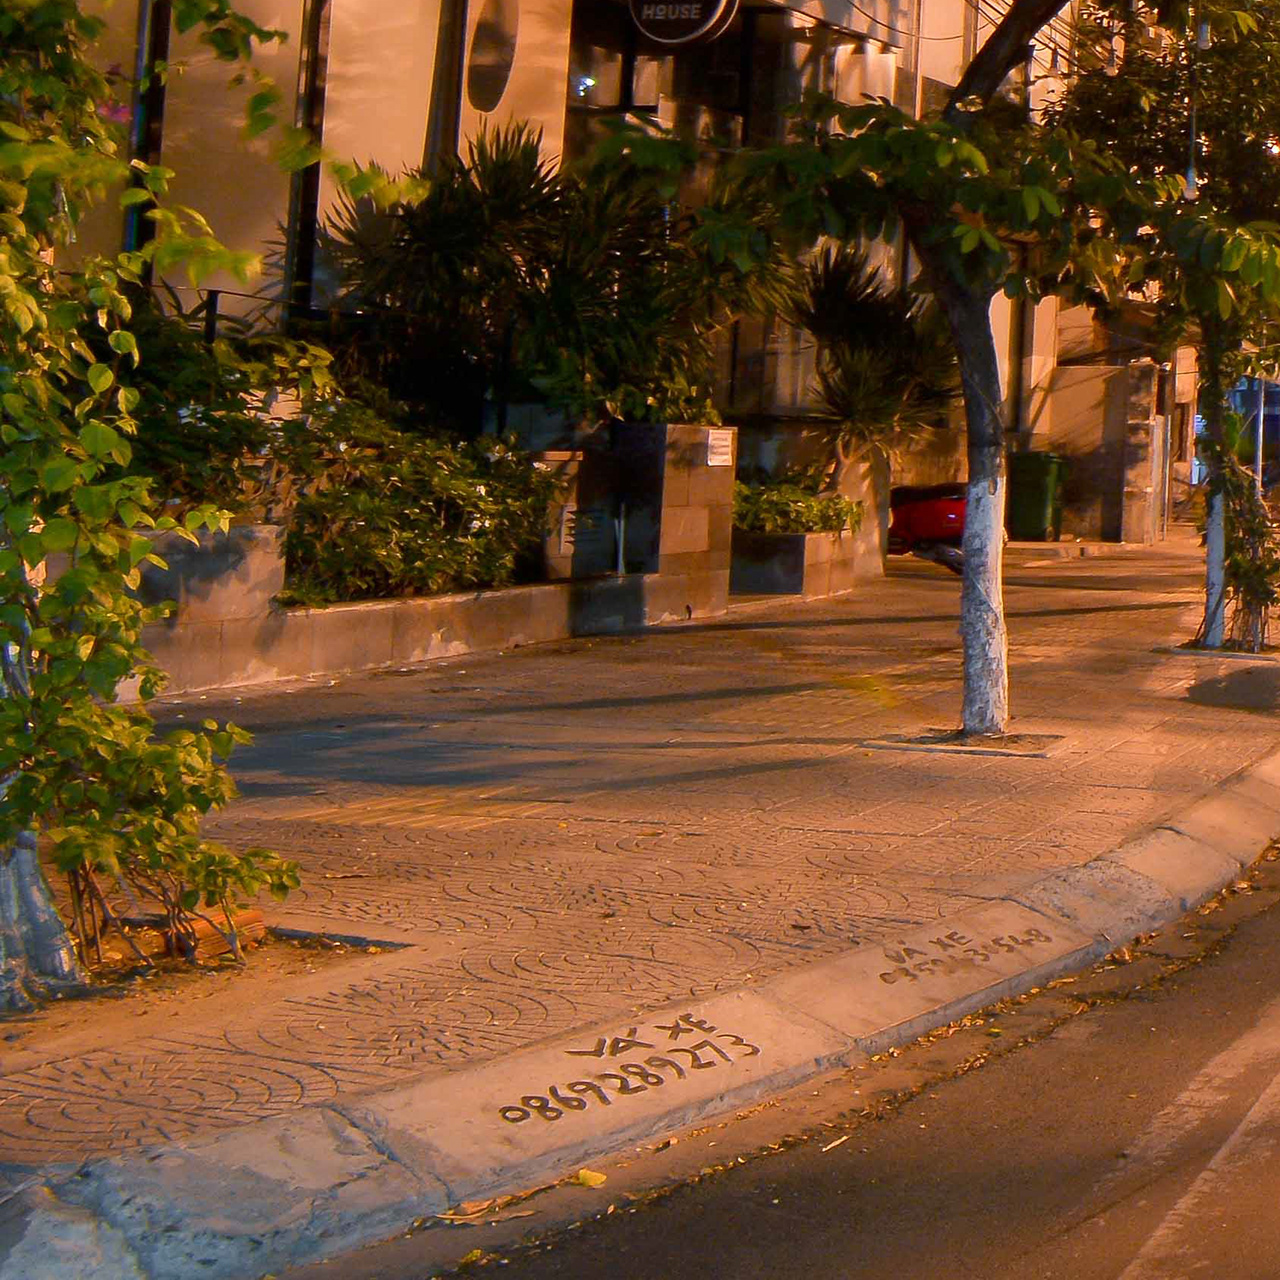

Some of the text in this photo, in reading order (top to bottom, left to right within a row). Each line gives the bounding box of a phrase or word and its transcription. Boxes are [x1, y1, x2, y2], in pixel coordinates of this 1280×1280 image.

[642, 4, 702, 20] HOUSE
[929, 931, 973, 951] XE
[653, 1013, 718, 1040] XE
[499, 1034, 761, 1123] 0869289273
